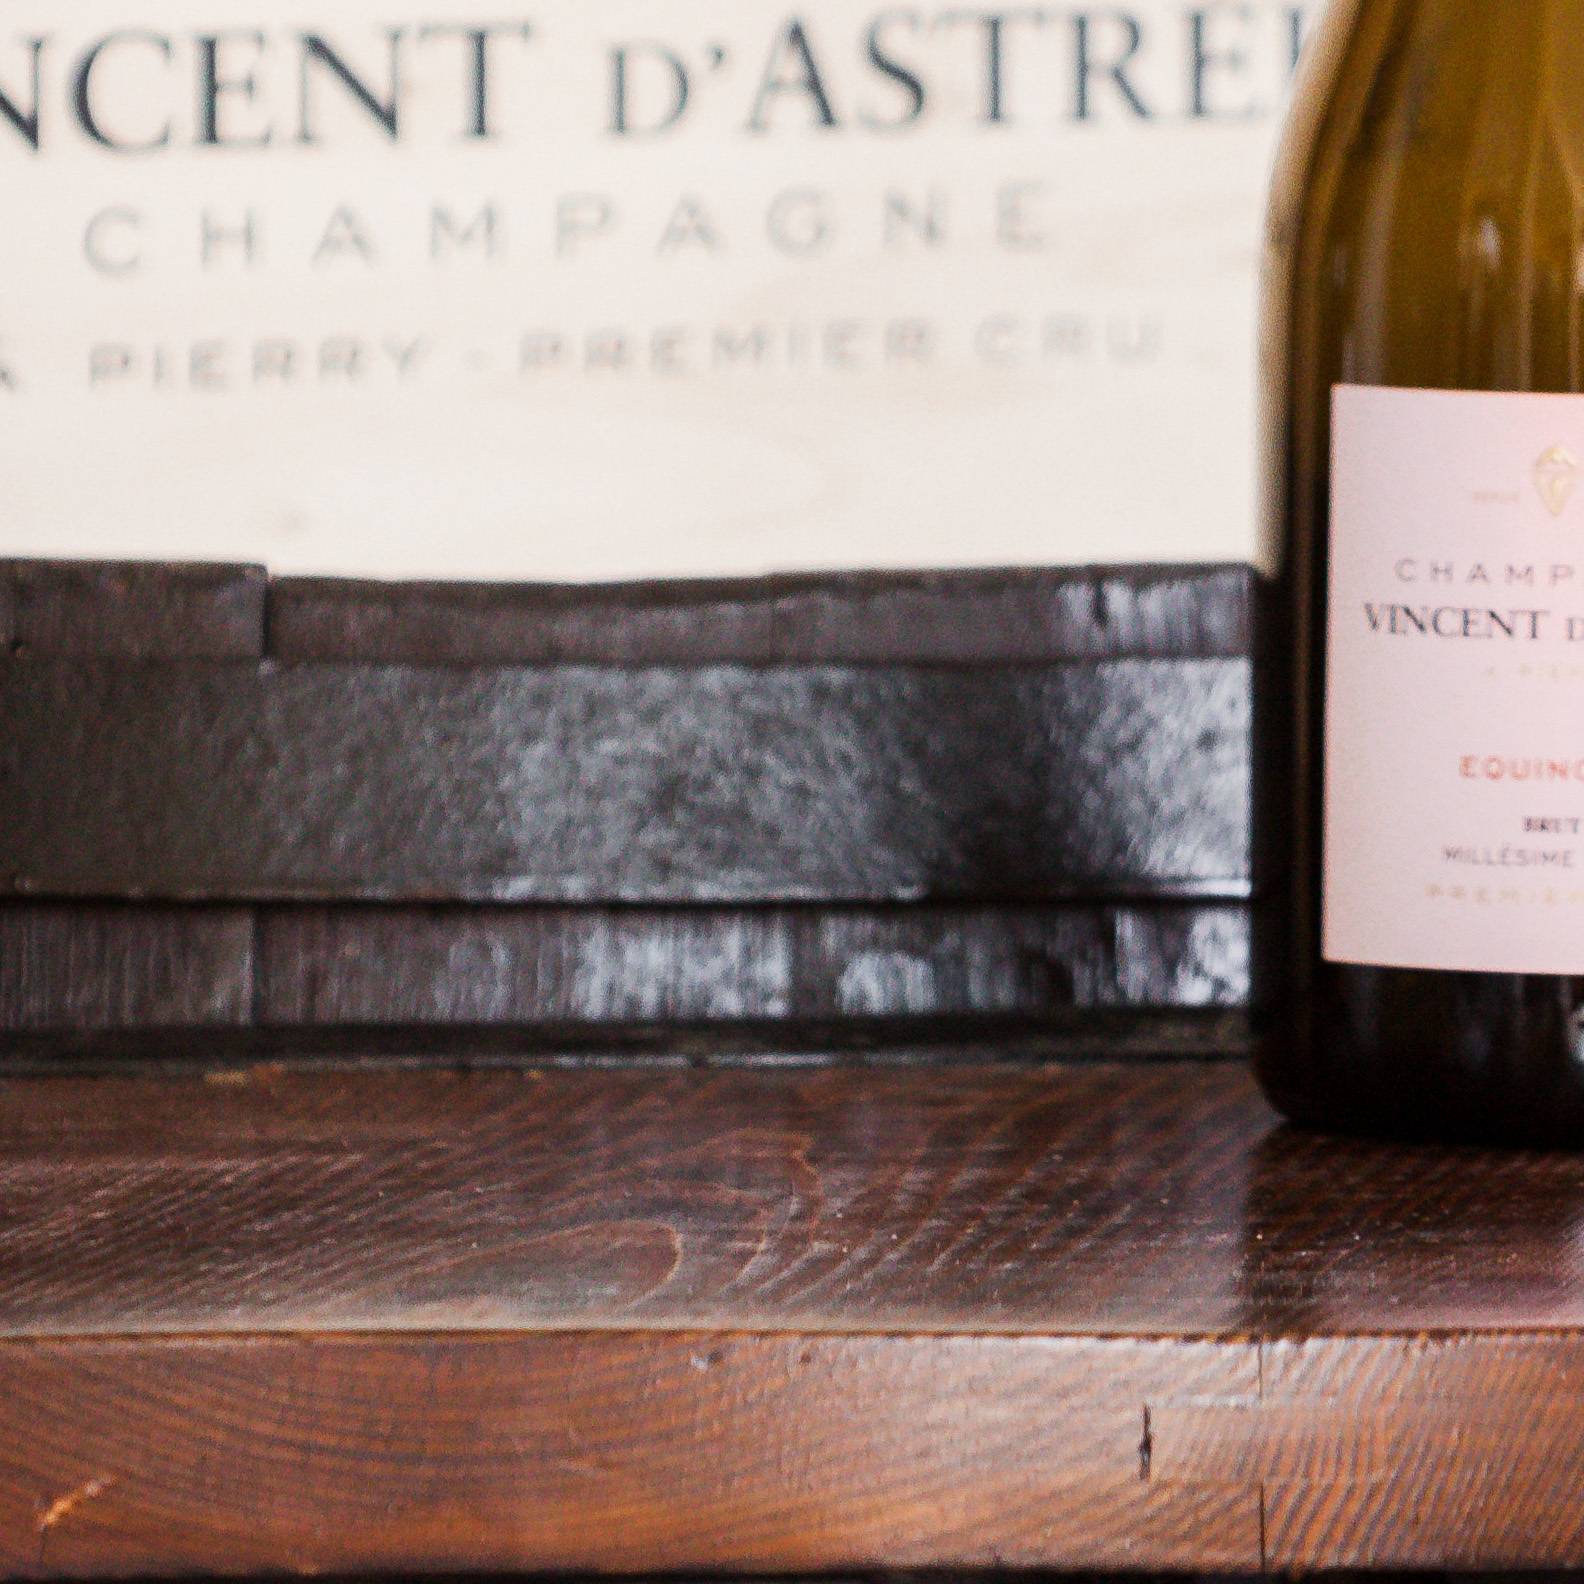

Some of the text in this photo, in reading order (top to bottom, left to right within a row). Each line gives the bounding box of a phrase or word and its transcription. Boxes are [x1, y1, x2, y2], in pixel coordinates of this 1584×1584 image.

[82, 178, 1050, 276] CHAMPAGNE
[87, 334, 428, 392] PIERRY
[516, 316, 934, 378] PREMIER
[972, 312, 1166, 366] CRU
[1362, 602, 1550, 642] VINCENT
